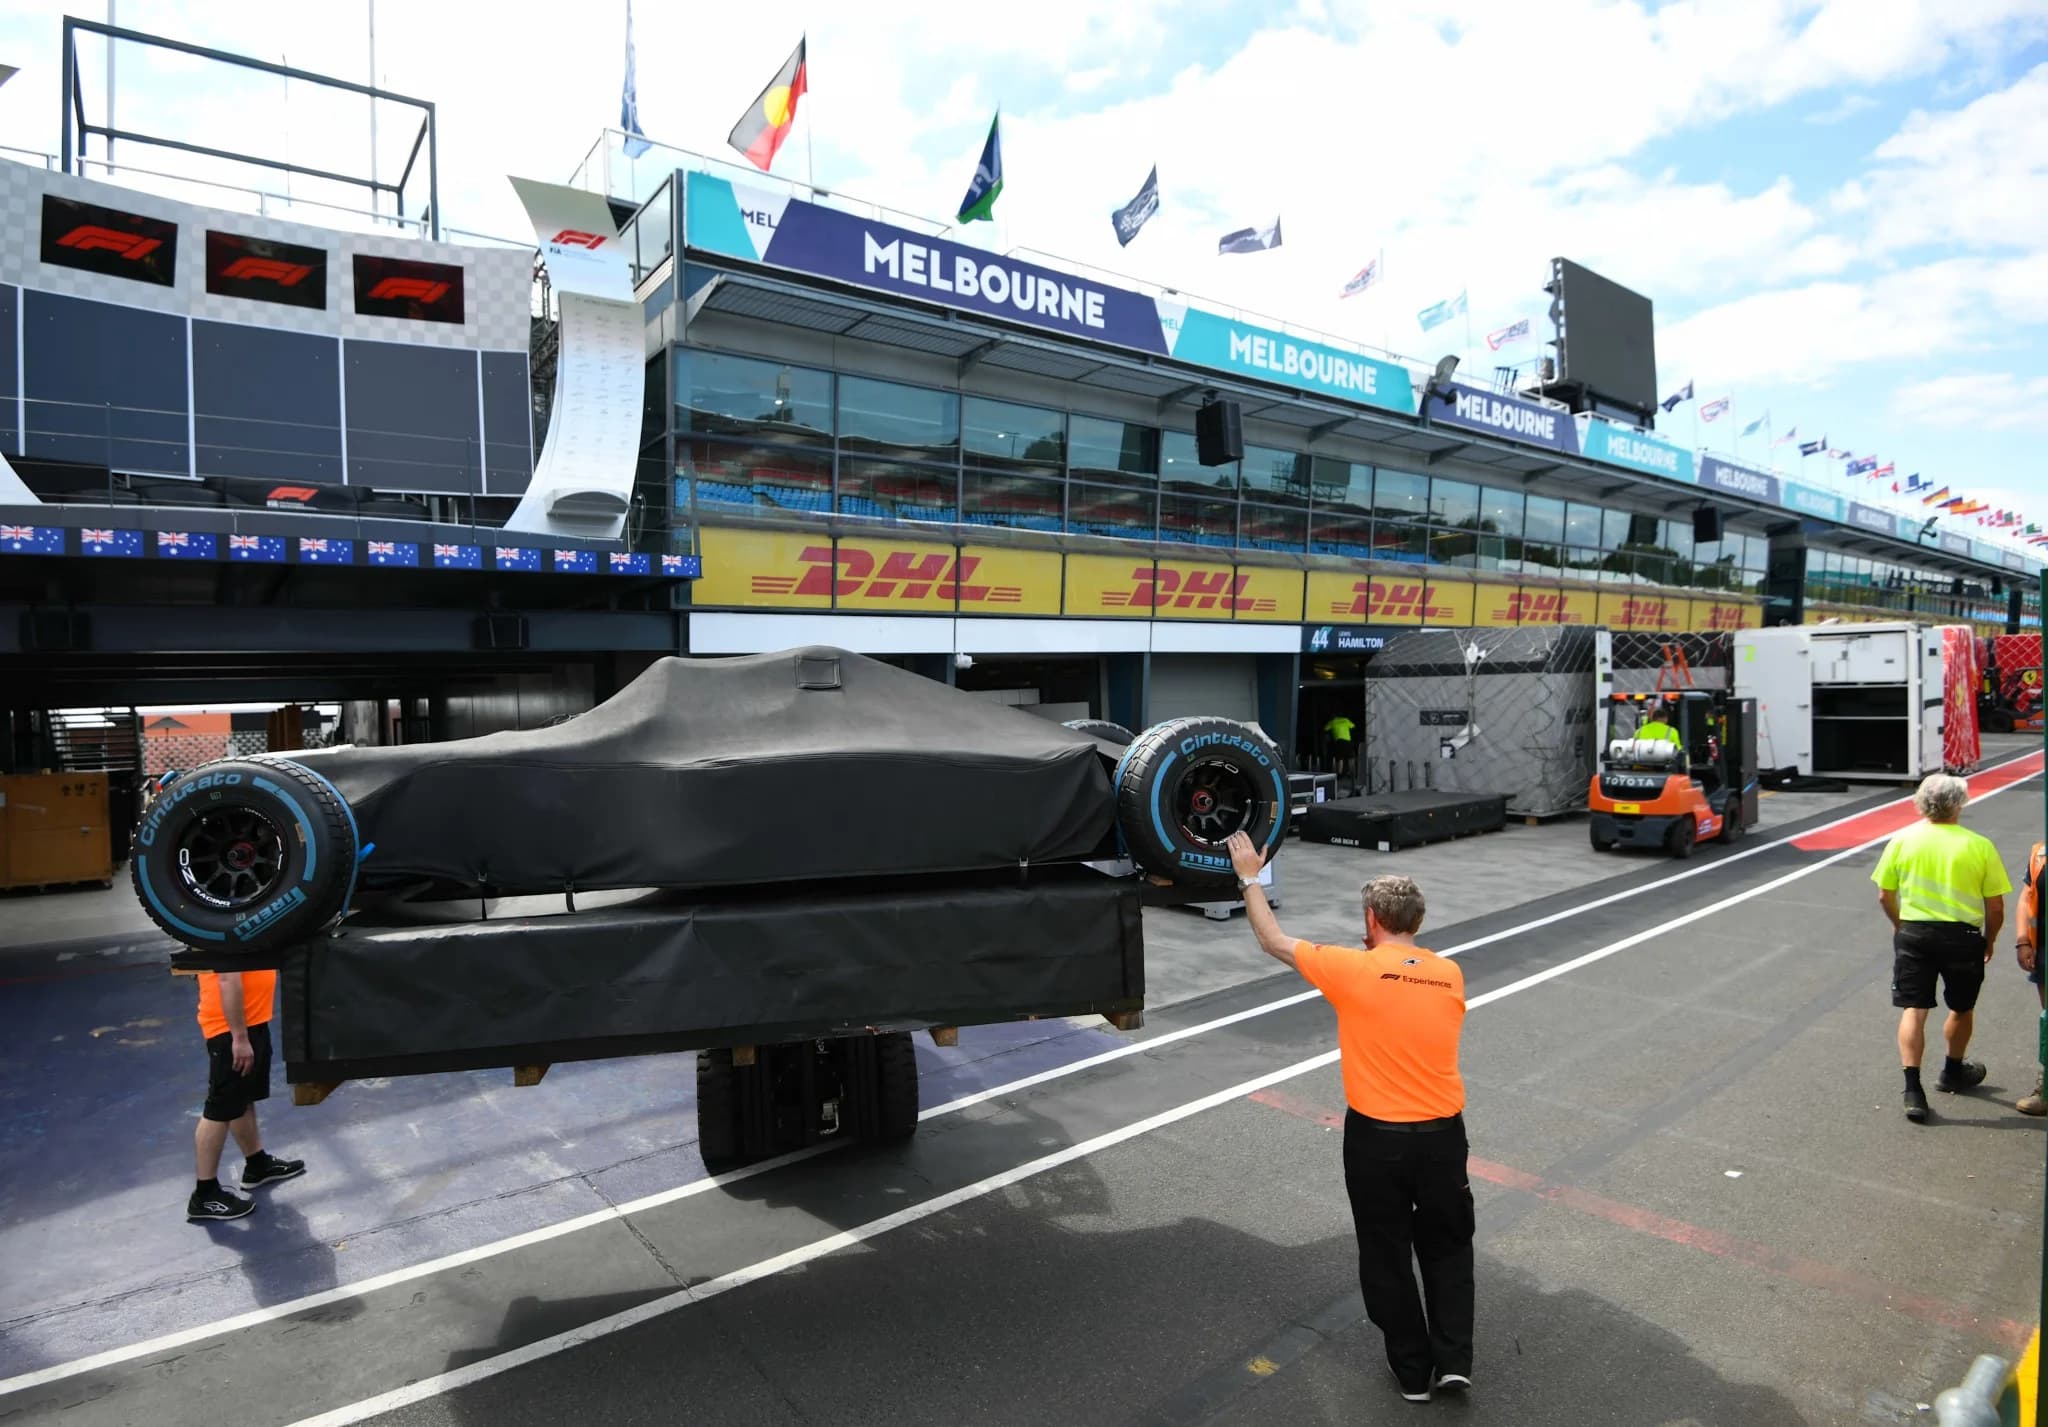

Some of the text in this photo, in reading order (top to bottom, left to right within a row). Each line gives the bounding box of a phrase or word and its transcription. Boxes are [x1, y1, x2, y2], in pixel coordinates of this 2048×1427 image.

[864, 230, 1106, 329] MELBOURNE
[1230, 328, 1377, 395] MELBOURNE
[1455, 390, 1556, 440] MELBOURNE
[1607, 434, 1677, 472] MELBOURNE
[1715, 466, 1768, 496] MELBOURNE
[793, 546, 992, 601] DHL
[1128, 567, 1257, 612] DHL
[1350, 581, 1441, 618] DHL
[1505, 593, 1570, 623] DHL
[1620, 600, 1668, 625] DHL
[1311, 629, 1328, 649] 44
[1338, 637, 1384, 649] HAMILTON
[1605, 776, 1655, 787] TOYOTA
[1179, 851, 1234, 874] IRELLI
[232, 886, 307, 941] PIRELLI
[1402, 975, 1452, 989] Experiences
